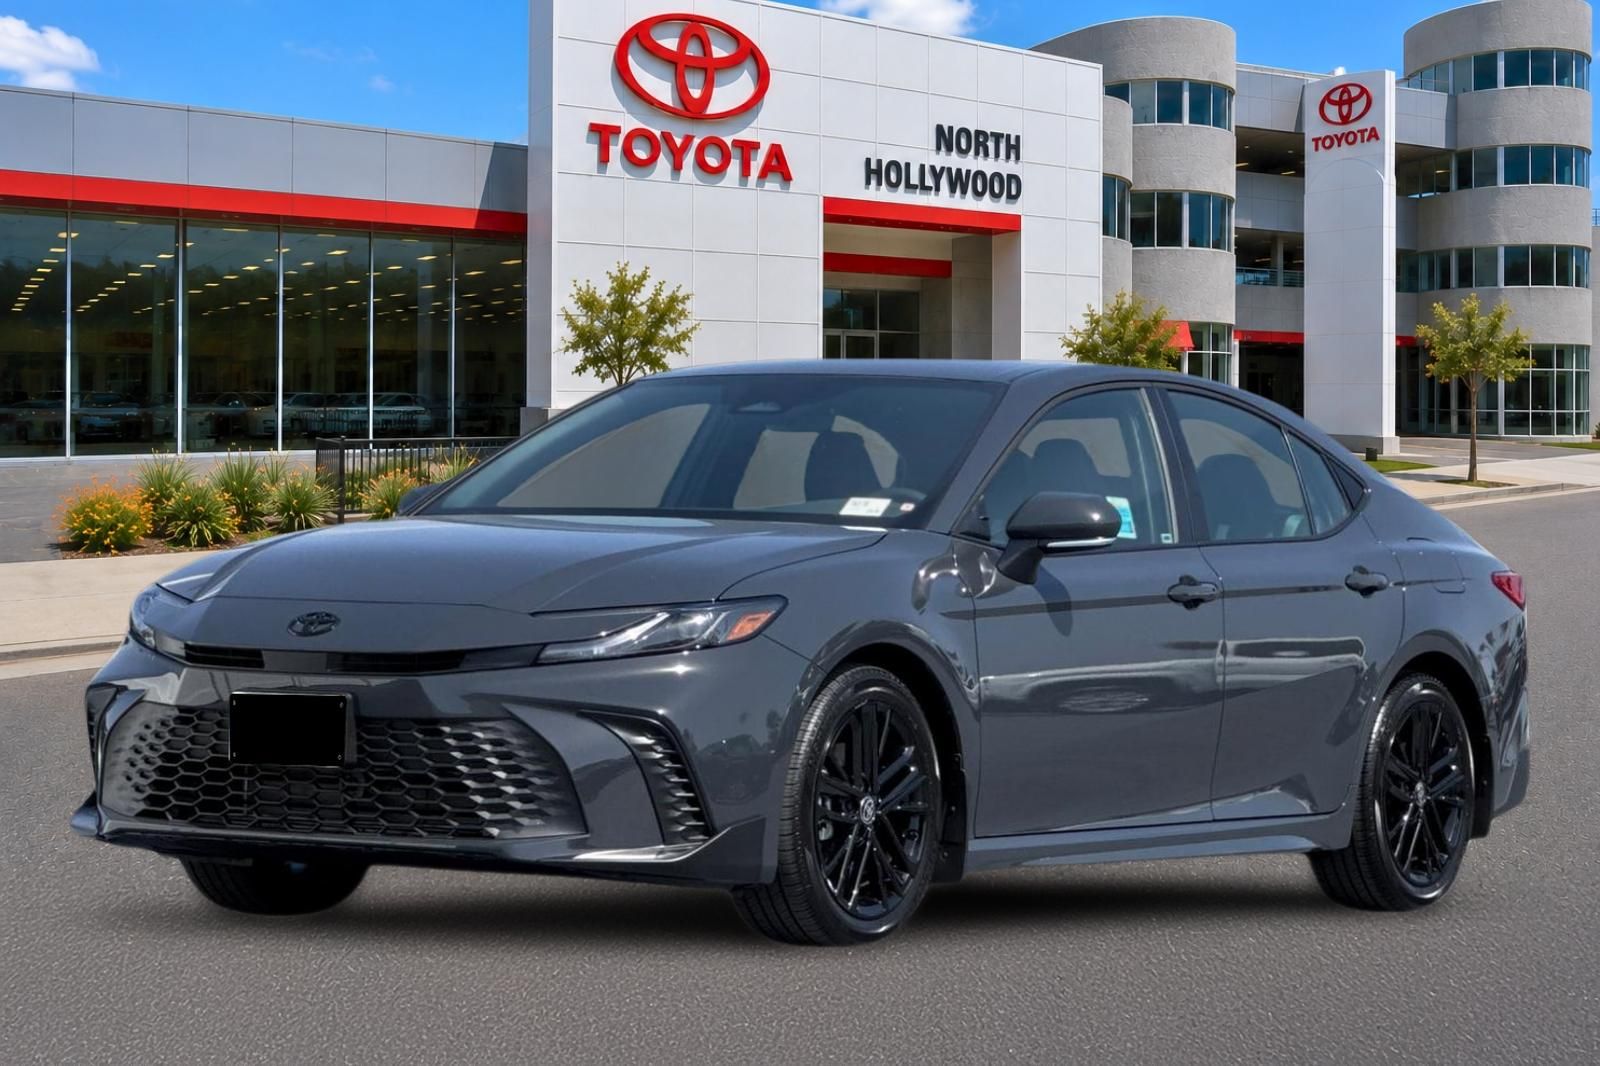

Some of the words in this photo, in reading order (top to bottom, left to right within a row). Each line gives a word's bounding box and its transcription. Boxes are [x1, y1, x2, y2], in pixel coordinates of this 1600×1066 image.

[588, 122, 793, 181] TOYOTA
[936, 124, 1021, 161] NORTH
[1312, 126, 1380, 152] TOYOTA
[865, 157, 1022, 200] HOLLYWOOD
